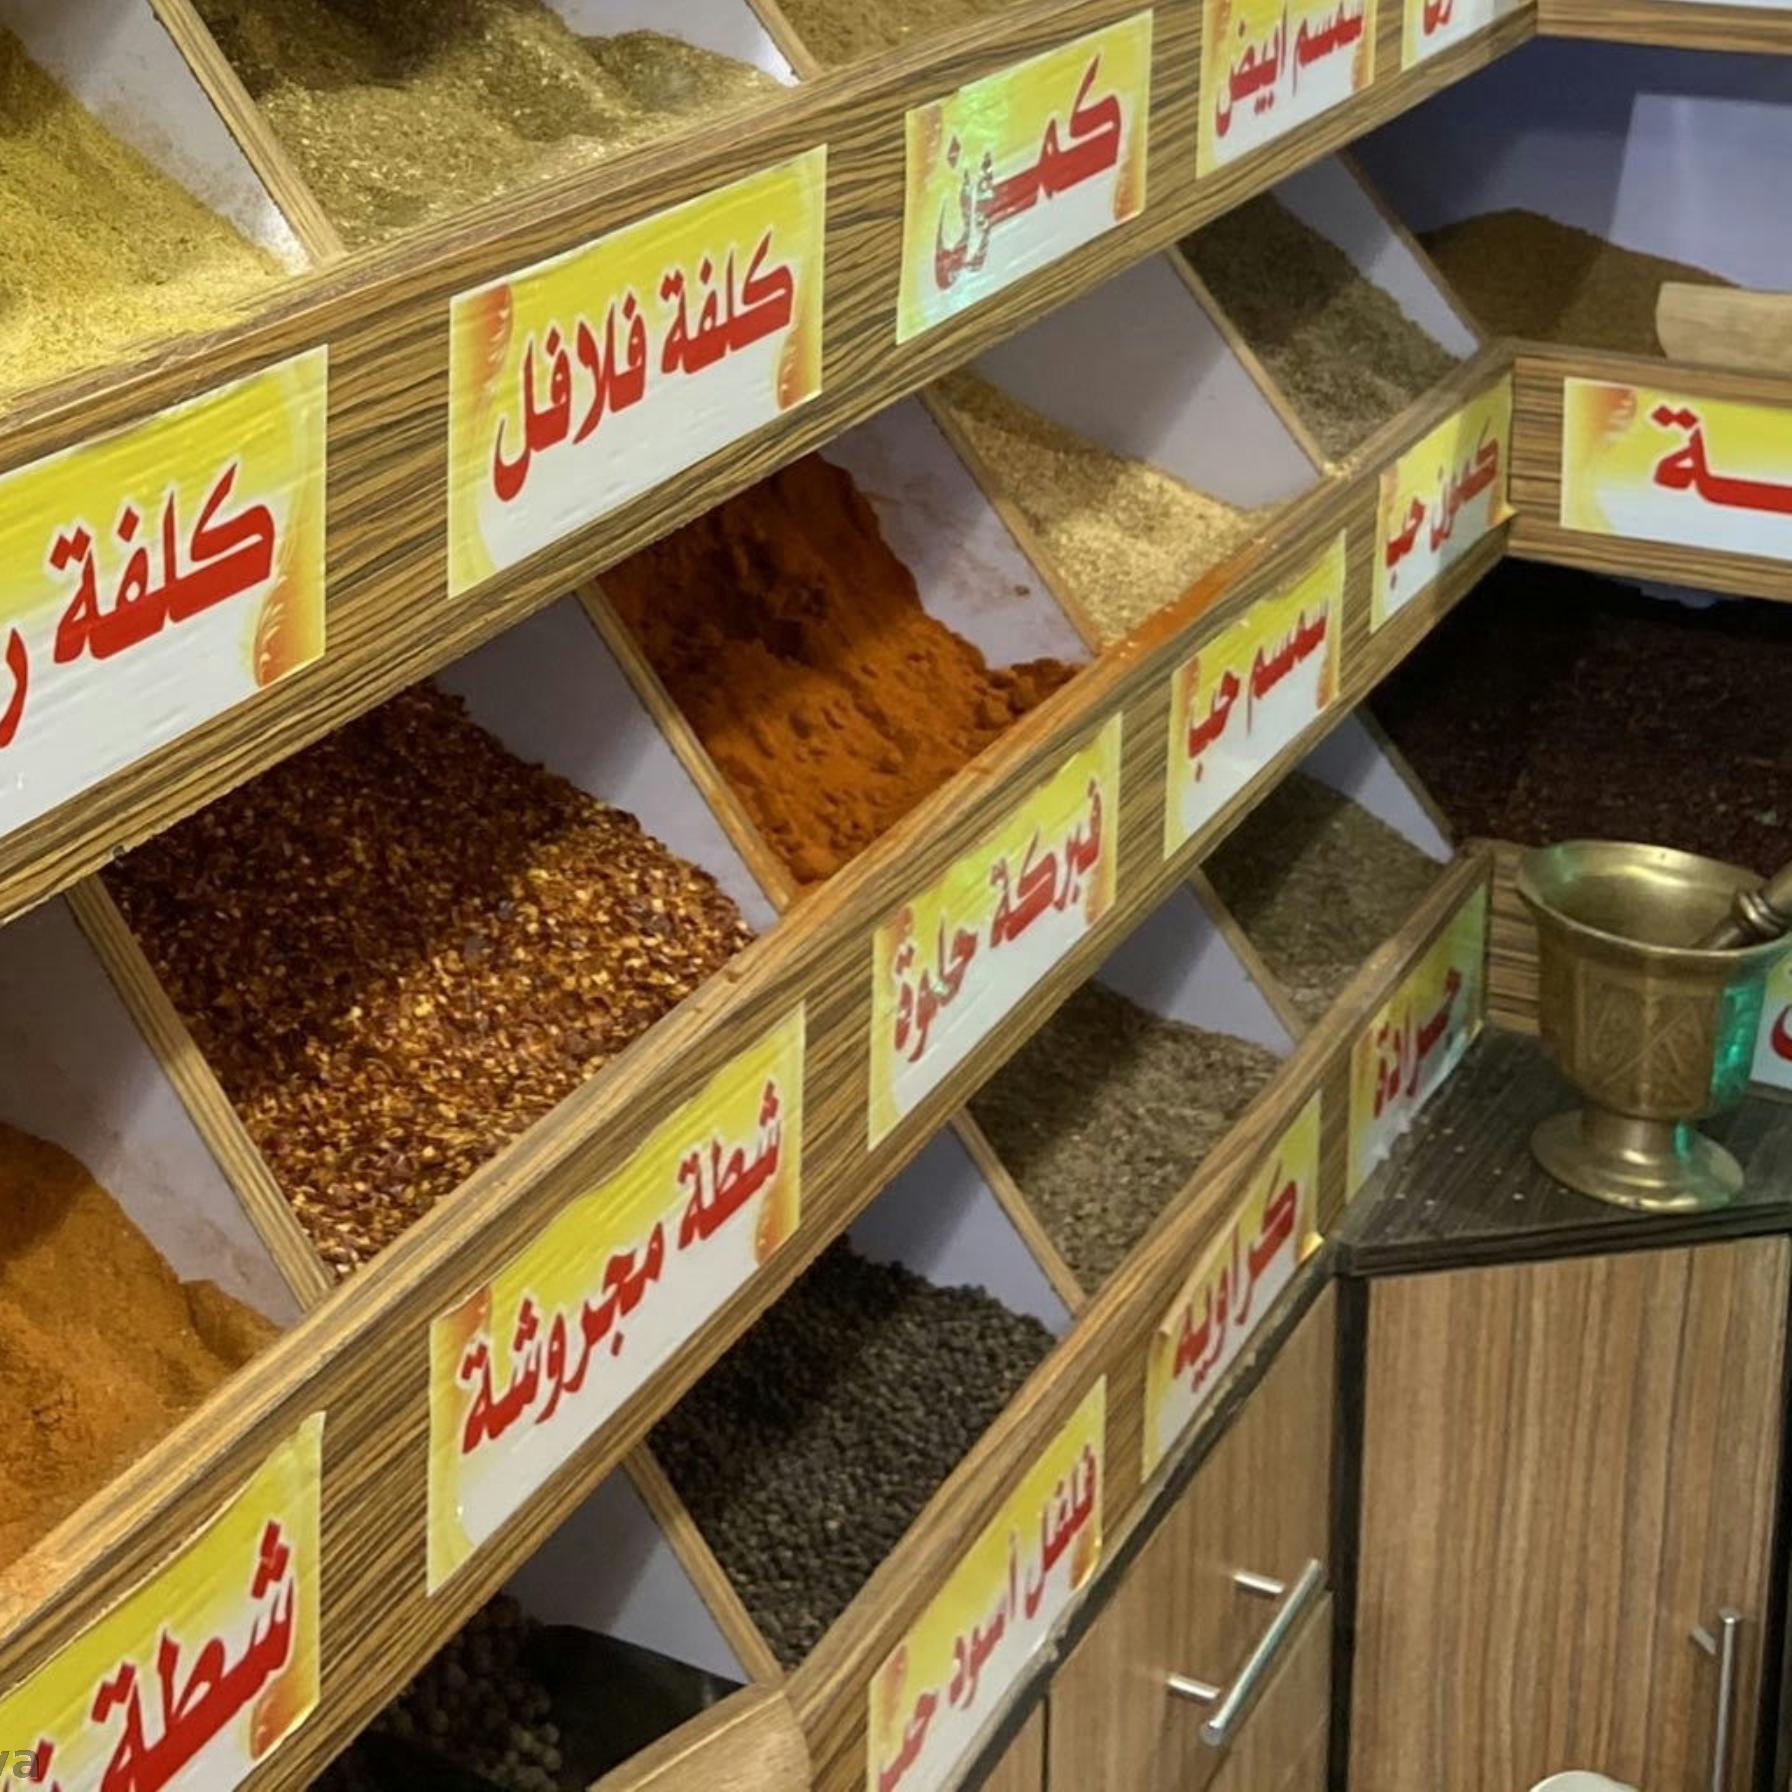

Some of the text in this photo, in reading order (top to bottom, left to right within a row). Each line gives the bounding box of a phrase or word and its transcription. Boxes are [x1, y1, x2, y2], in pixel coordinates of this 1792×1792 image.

[934, 52, 1124, 294] كمون
[492, 230, 795, 502] كلفة فلافل
[53, 472, 275, 664] كلفة
[1385, 496, 1428, 592] حب
[1188, 600, 1332, 784] سمسم حب
[893, 908, 980, 1064] حلوة
[460, 1080, 782, 1456] شطة مجروشة
